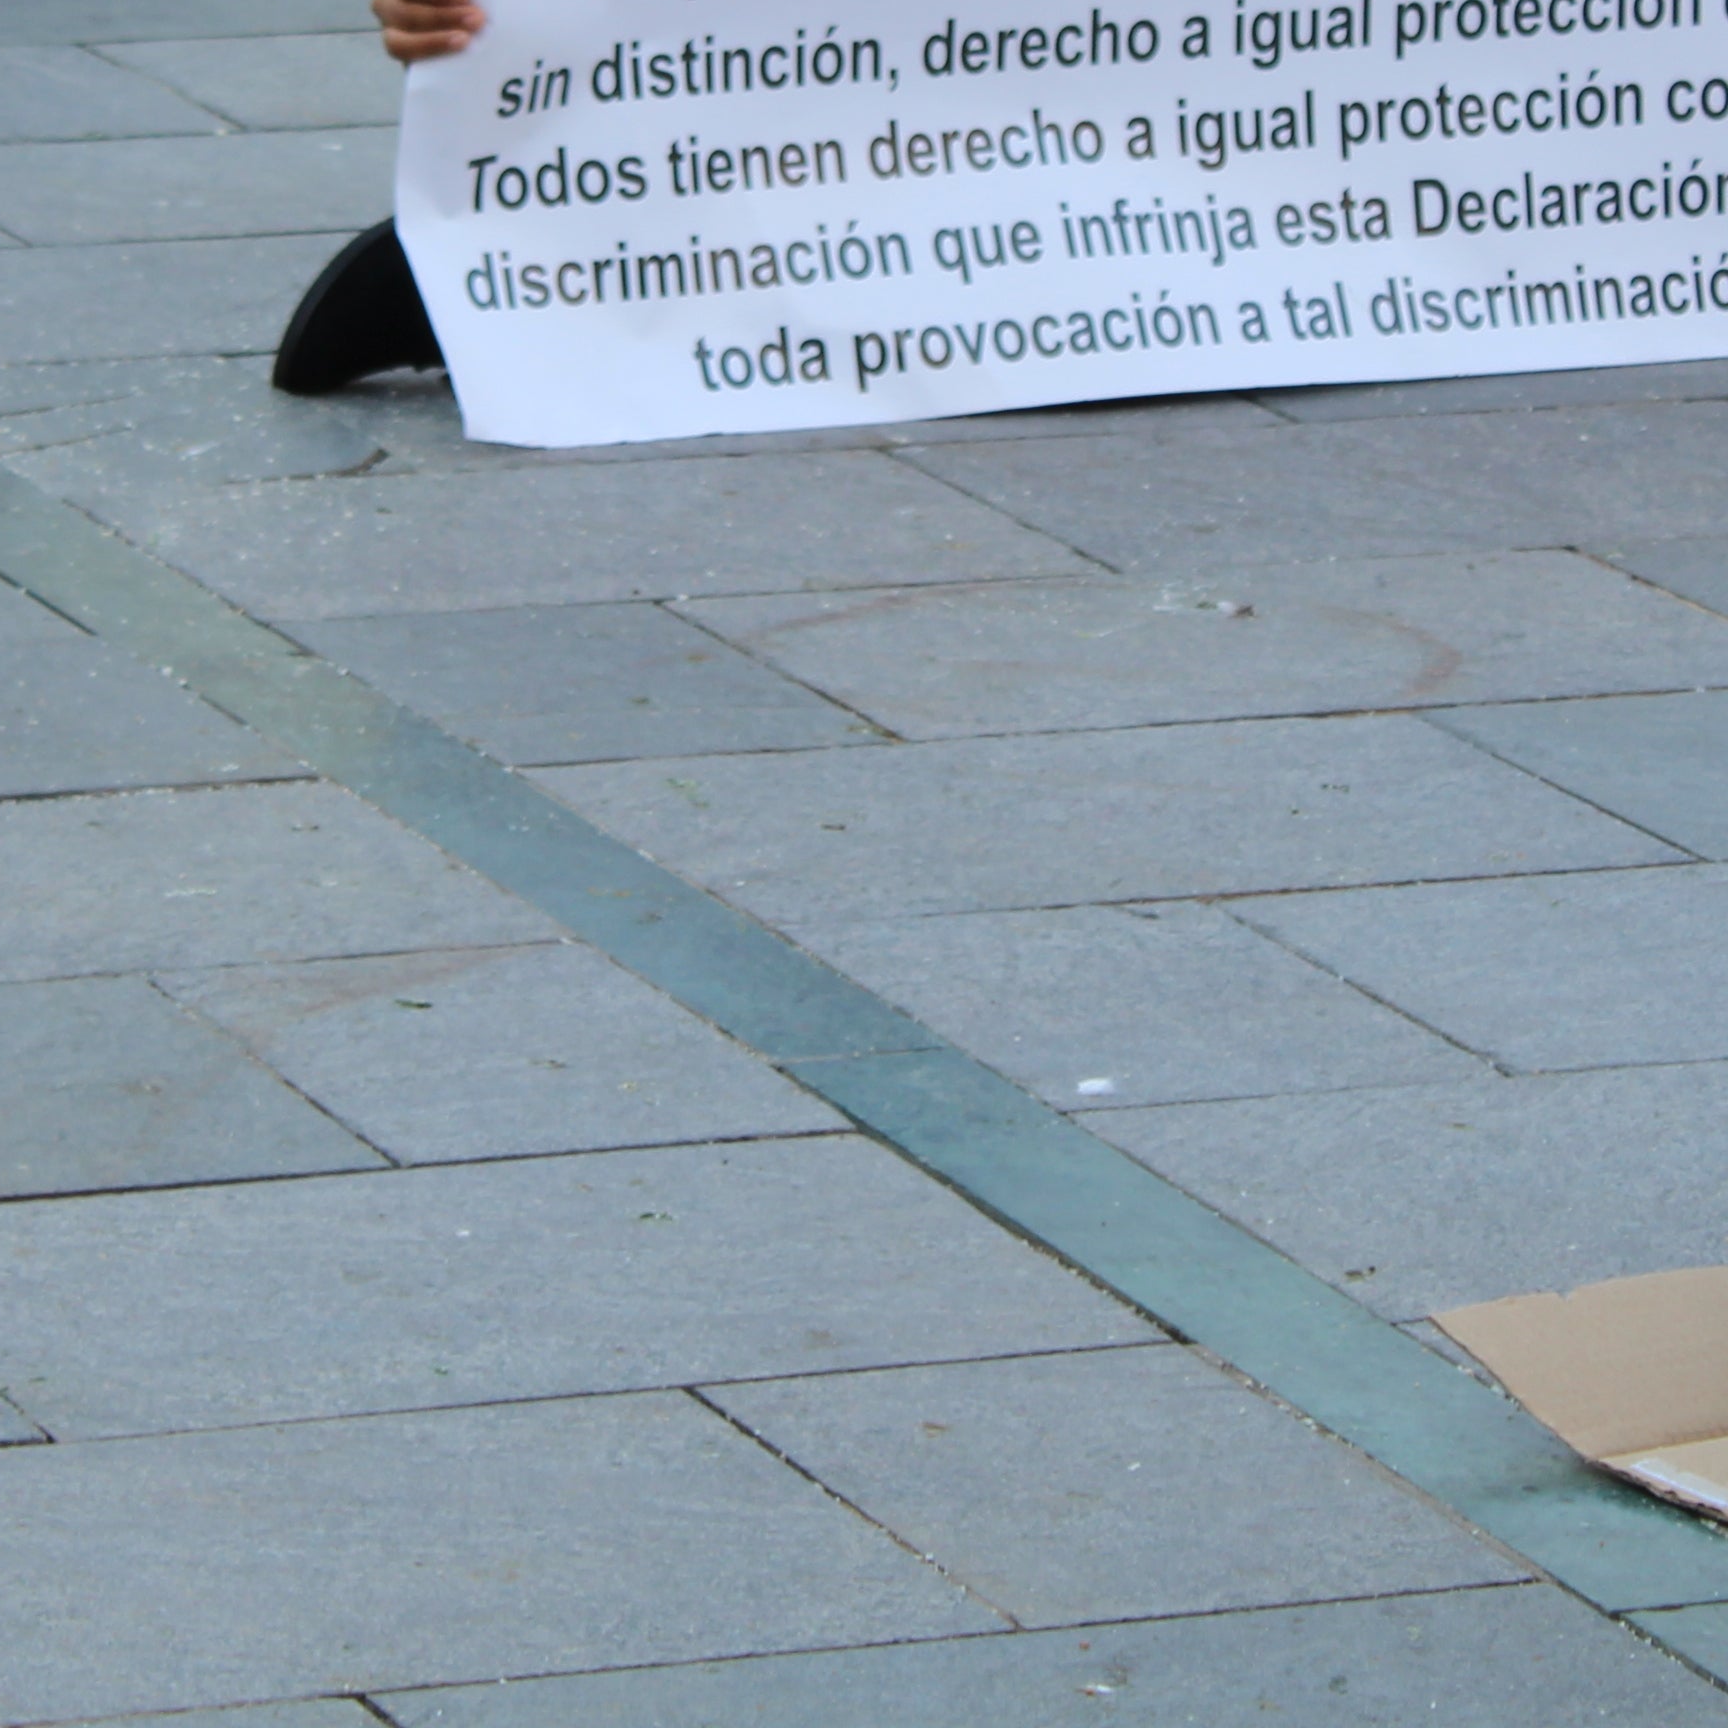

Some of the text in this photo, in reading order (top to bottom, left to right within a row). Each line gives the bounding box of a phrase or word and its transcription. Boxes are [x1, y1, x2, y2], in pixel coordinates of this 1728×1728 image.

[496, 59, 572, 119] sin
[590, 25, 899, 103] distinción,
[921, 7, 1161, 78] derecho
[1180, 14, 1211, 60] a
[467, 145, 649, 214] Todos
[666, 134, 847, 198] tienen
[867, 107, 1105, 180] derecho
[1126, 115, 1158, 160] a
[1176, 89, 1316, 172] igual
[1338, 68, 1644, 162] protección
[465, 219, 913, 311] discriminación
[932, 219, 1043, 285] que
[1059, 193, 1257, 267] infrinja
[1274, 187, 1392, 247] esta
[693, 325, 832, 392] toda
[851, 289, 1222, 394] provocación
[1237, 300, 1271, 344] a
[1282, 280, 1352, 341] tal
